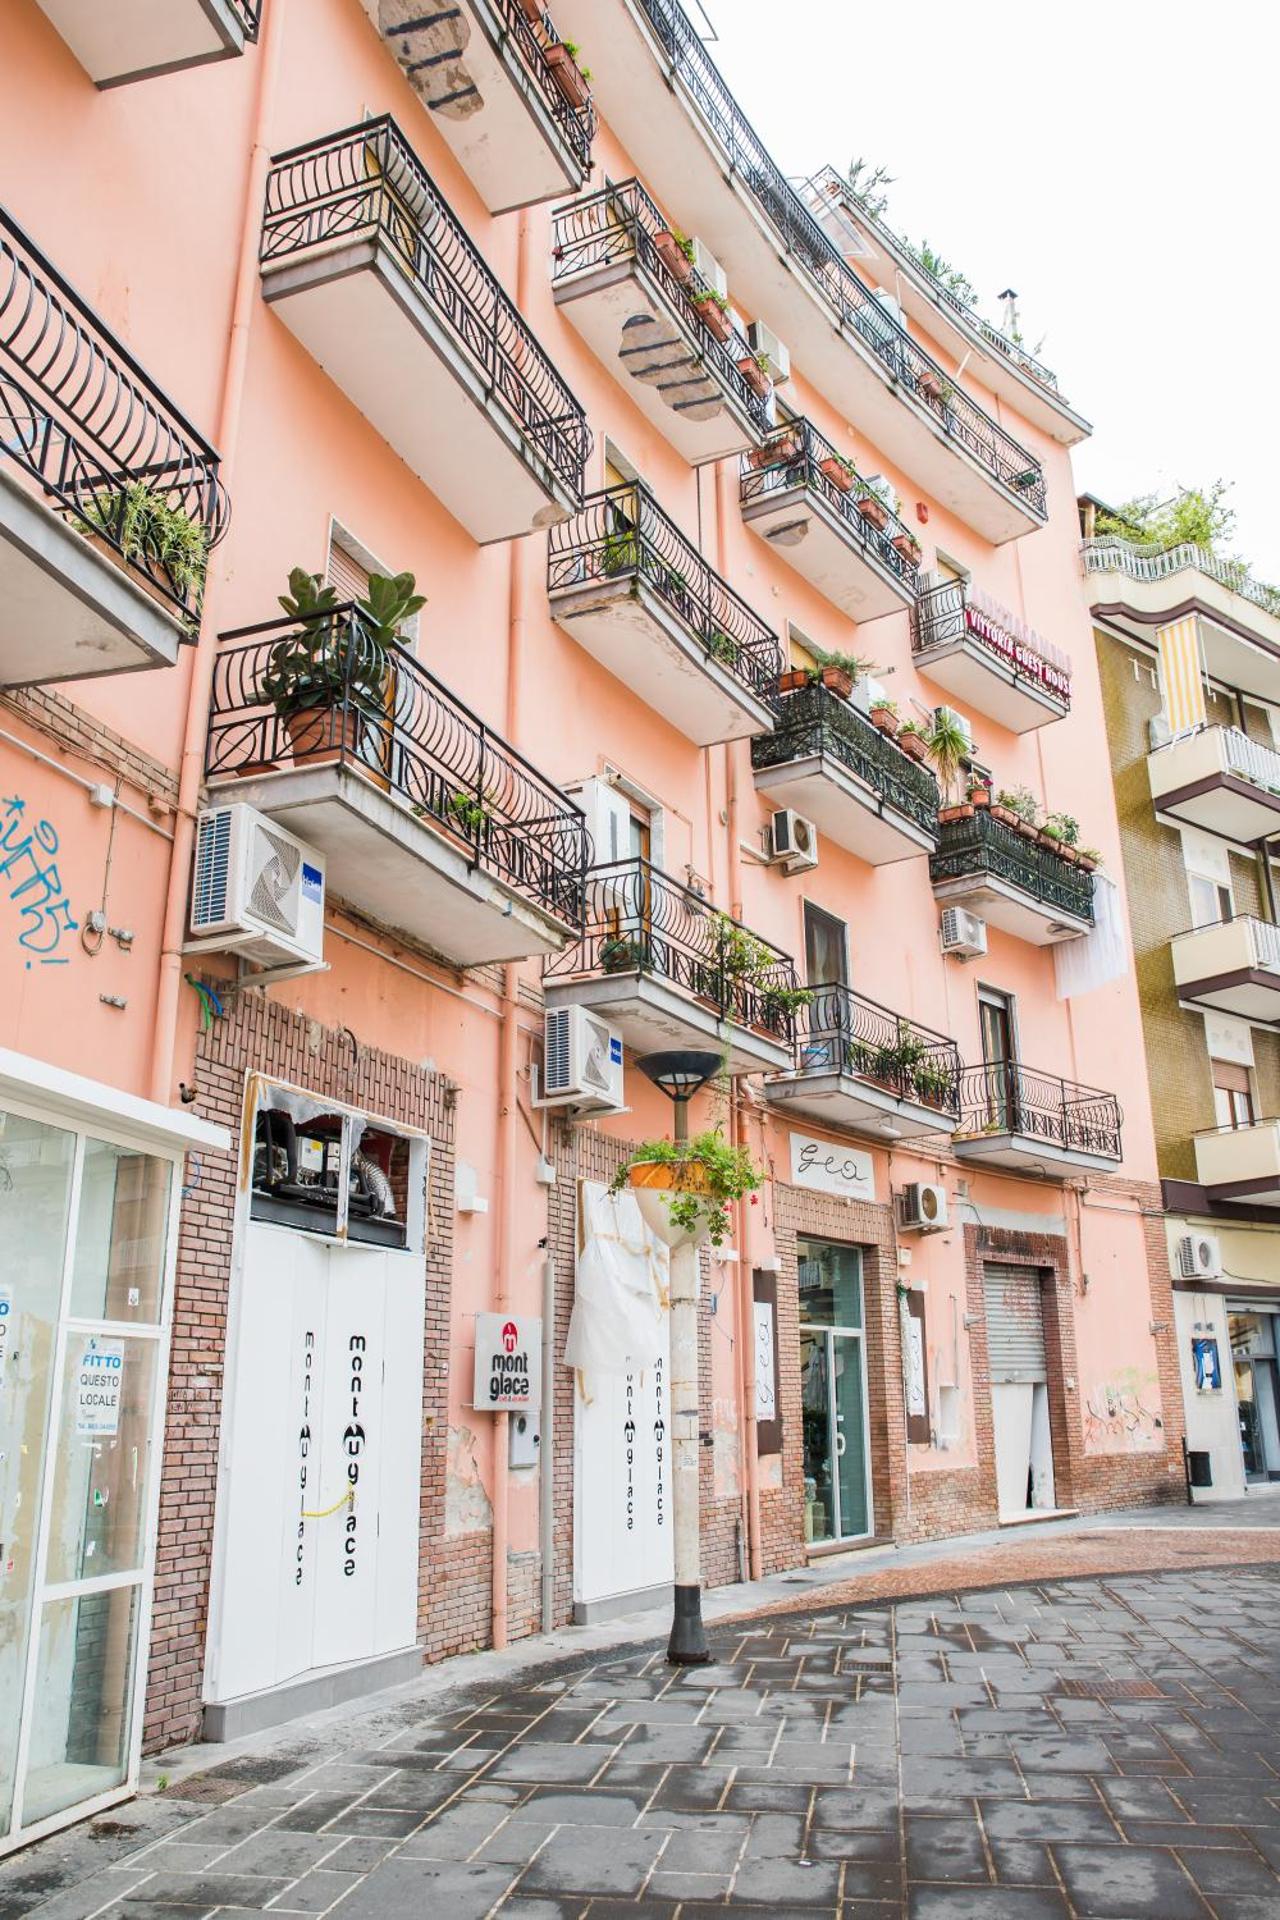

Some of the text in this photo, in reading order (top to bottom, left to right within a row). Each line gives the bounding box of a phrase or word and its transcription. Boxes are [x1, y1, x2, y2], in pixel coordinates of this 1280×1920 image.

[82, 1354, 121, 1368] FITTO
[492, 1352, 528, 1373] mont
[80, 1374, 119, 1387] QUESTO
[490, 1372, 529, 1401] glace
[80, 1393, 117, 1406] LOCALE
